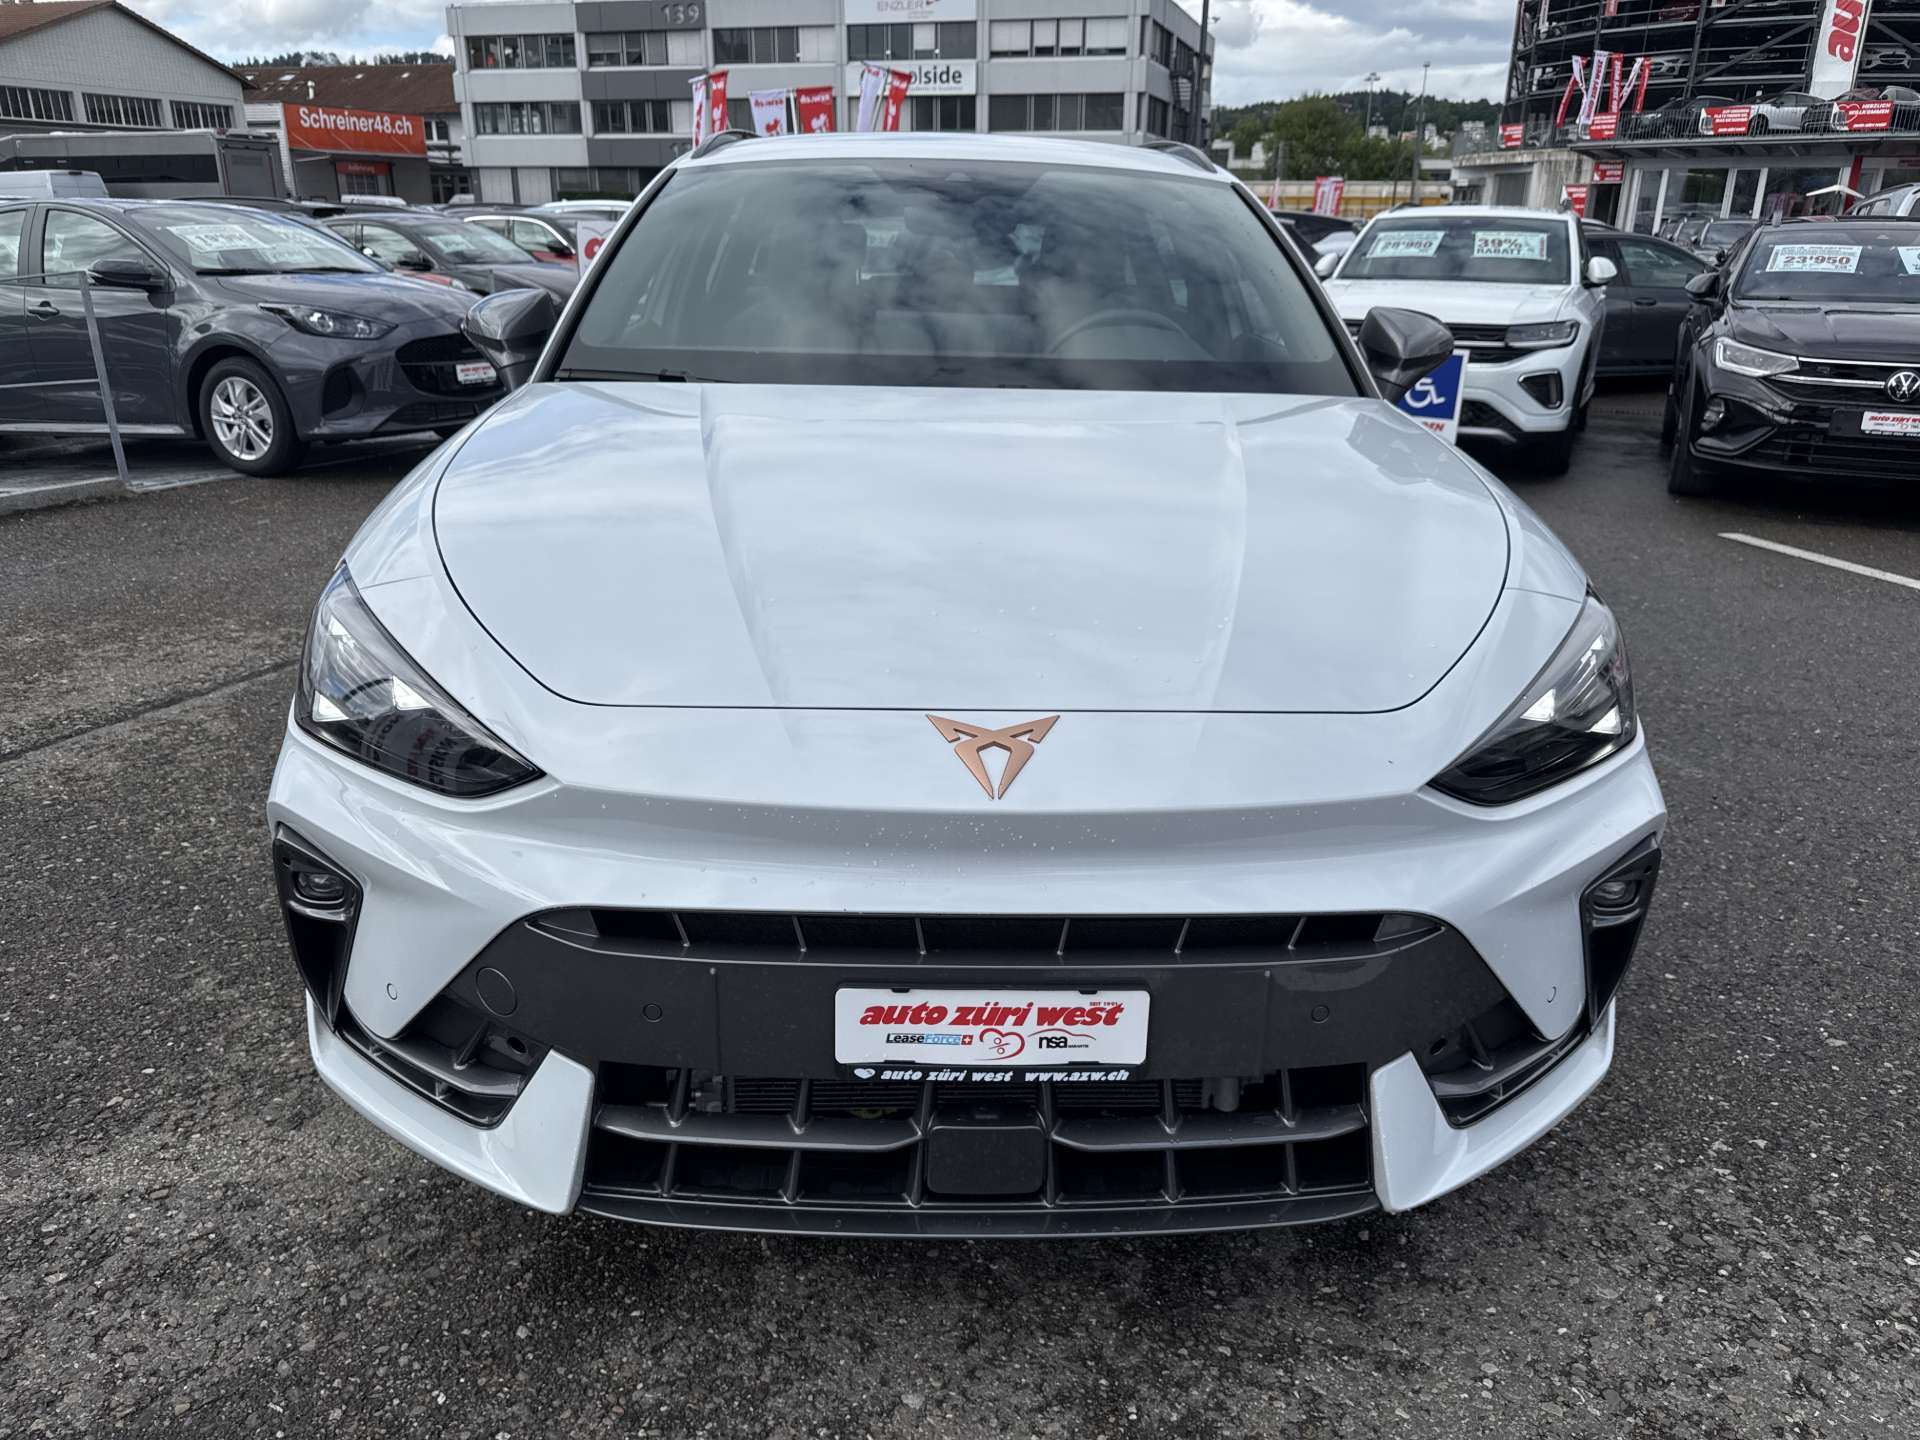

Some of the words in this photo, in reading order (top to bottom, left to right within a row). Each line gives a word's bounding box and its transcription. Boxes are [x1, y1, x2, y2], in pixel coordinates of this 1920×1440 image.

[662, 4, 699, 24] 139
[299, 107, 413, 135] Schreiner48.ch
[1783, 255, 1850, 264] 23'950
[859, 1001, 948, 1026] auto
[947, 1001, 1034, 1027] züri
[1036, 1002, 1125, 1027] west
[886, 1033, 960, 1045] LeaseForce
[1038, 1036, 1068, 1049] nsa
[881, 1069, 922, 1080] auto
[926, 1068, 968, 1081] züri
[971, 1070, 1014, 1082] west
[1024, 1069, 1130, 1082] www.azw.ch
